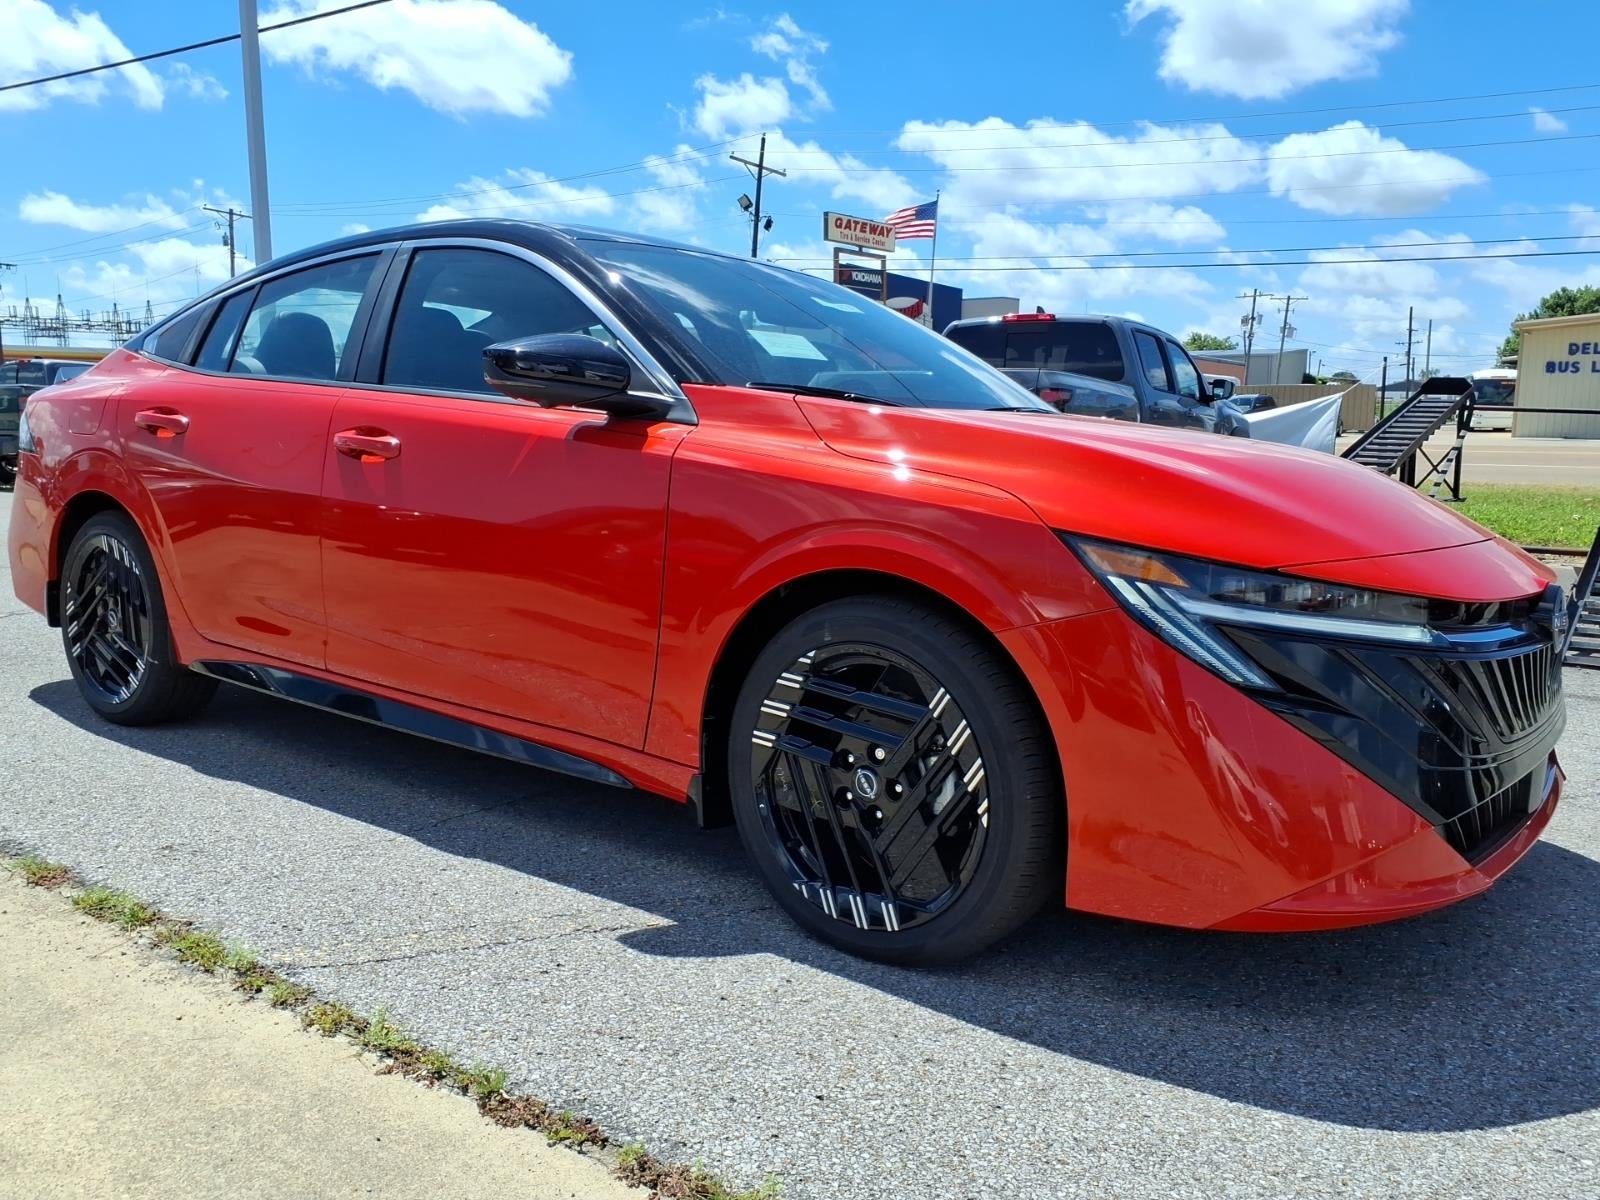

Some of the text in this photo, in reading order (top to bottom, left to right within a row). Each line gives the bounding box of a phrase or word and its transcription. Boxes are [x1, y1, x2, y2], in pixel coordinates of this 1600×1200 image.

[835, 217, 893, 238] GATEWAY
[851, 271, 882, 284] YOKOHAMA
[1545, 360, 1580, 374] BUS
